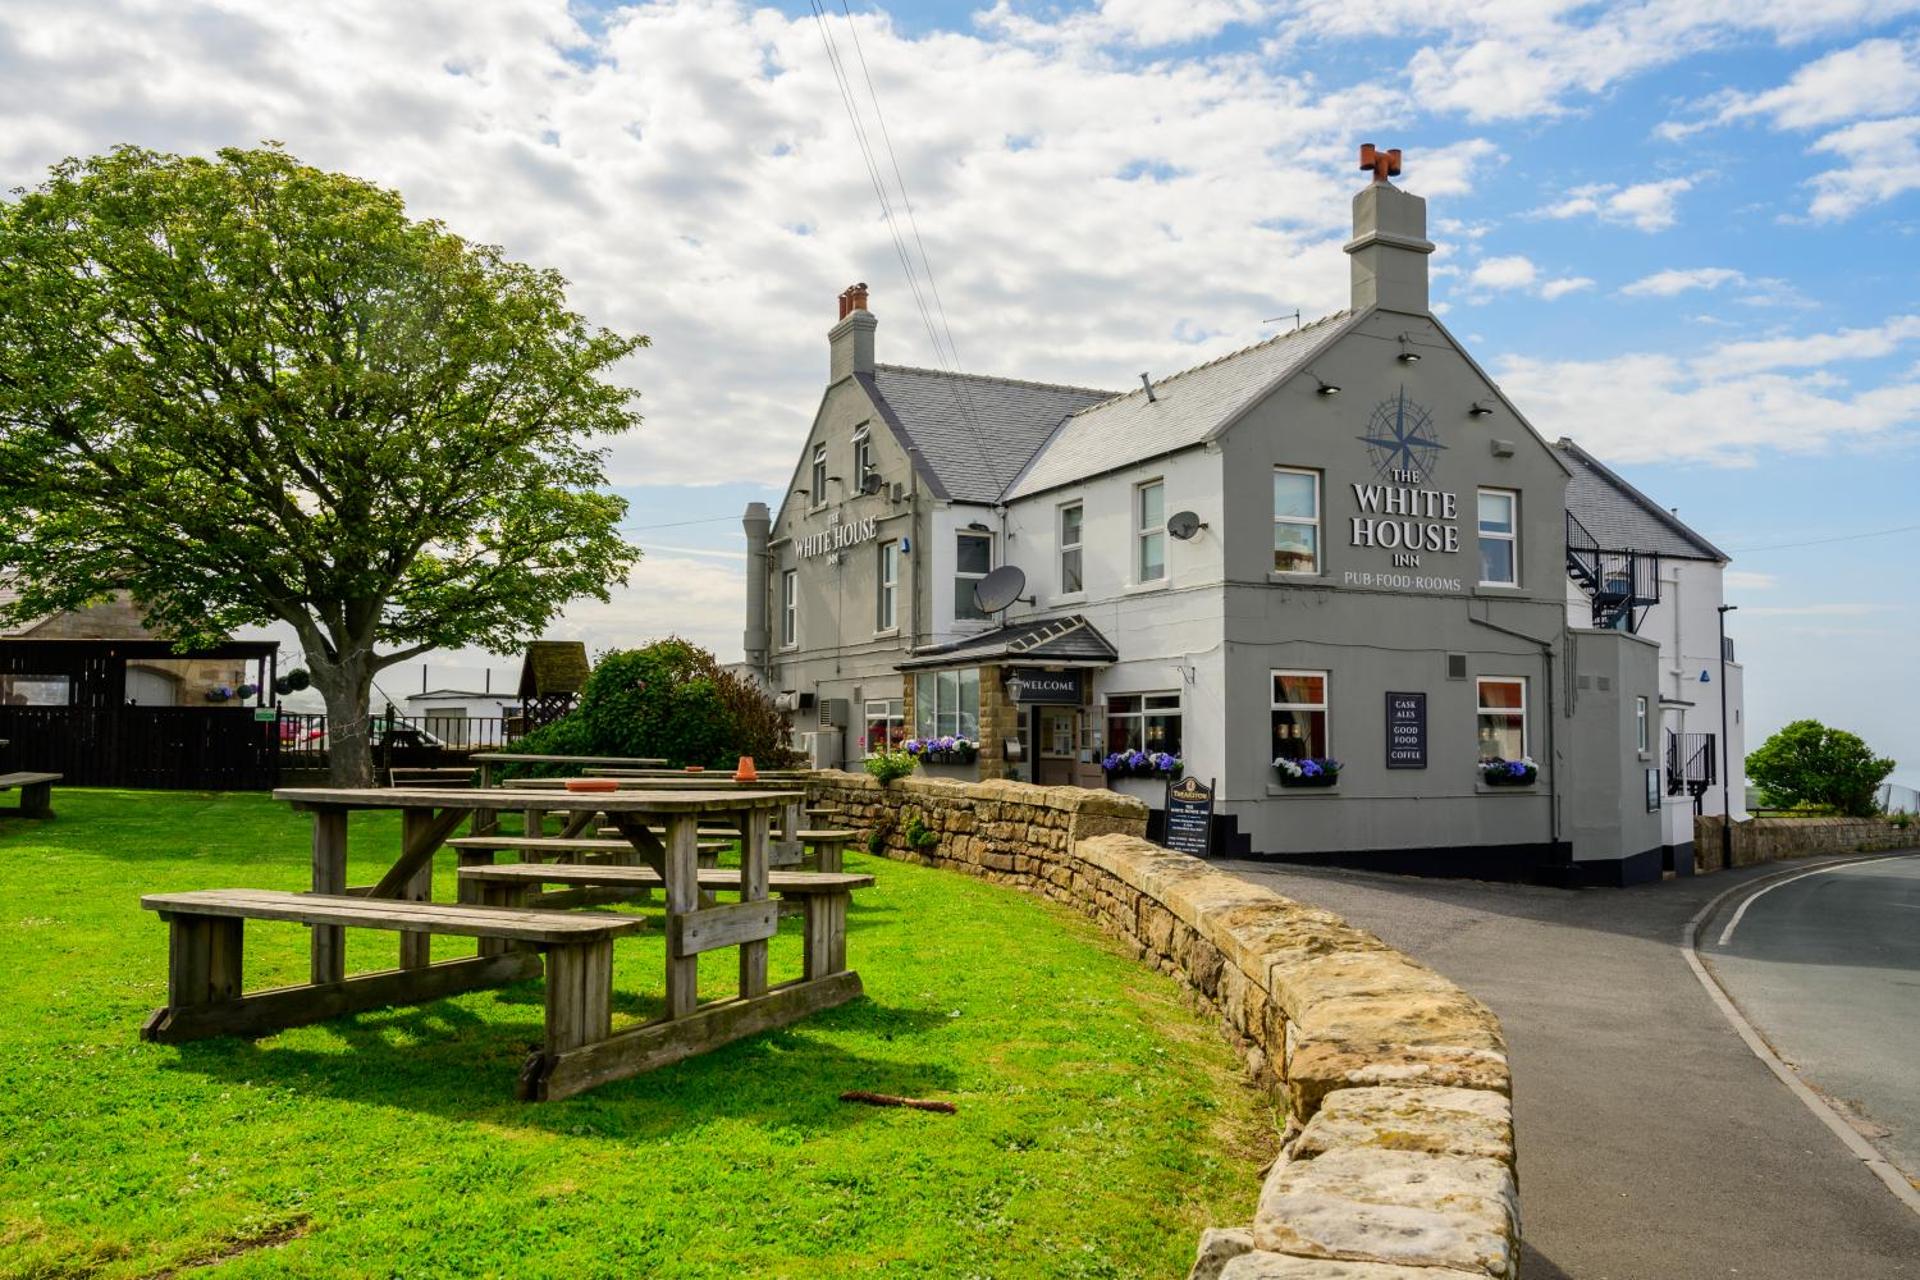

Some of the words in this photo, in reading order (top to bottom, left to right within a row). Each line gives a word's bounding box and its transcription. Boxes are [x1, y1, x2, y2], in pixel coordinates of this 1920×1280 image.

[1392, 469, 1420, 484] THE
[1352, 483, 1457, 519] WHITE
[795, 530, 831, 559] WHITE
[833, 514, 877, 550] HOUSE
[1351, 517, 1460, 553] HOUSE
[1394, 554, 1420, 567] INN
[1022, 680, 1074, 691] WELCOME
[1395, 700, 1416, 709] CASK
[1396, 710, 1415, 718] ALES
[1393, 726, 1418, 734] GOOD
[1394, 736, 1418, 744] FOOD
[1391, 751, 1420, 759] COFFEE
